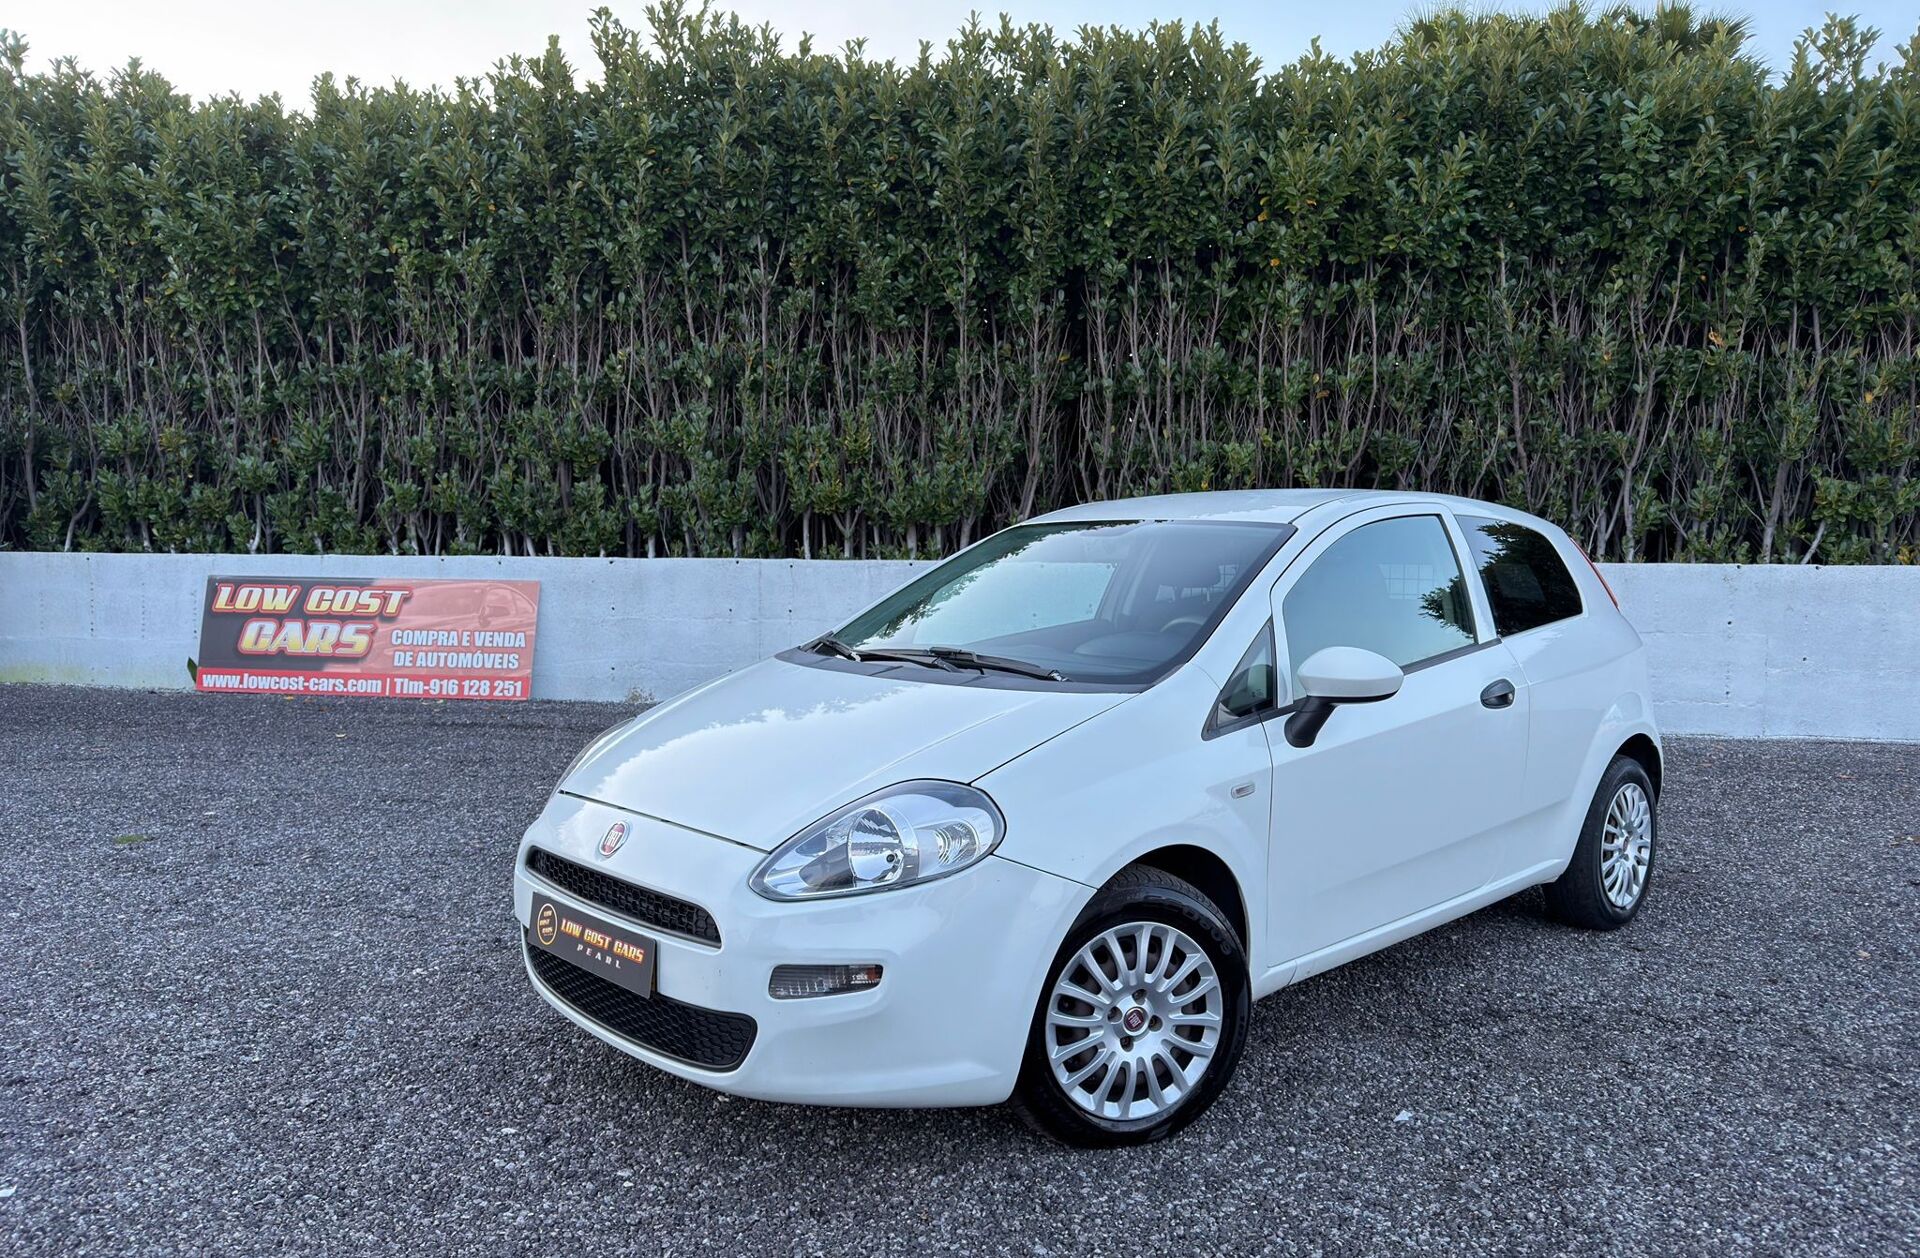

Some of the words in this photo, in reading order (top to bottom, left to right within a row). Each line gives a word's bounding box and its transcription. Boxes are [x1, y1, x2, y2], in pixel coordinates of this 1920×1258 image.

[213, 584, 300, 613] LOW
[304, 586, 412, 617] COST
[239, 619, 375, 656] CARS
[391, 629, 458, 647] COMPRA
[462, 631, 471, 647] E
[474, 631, 526, 648] VENDA
[393, 651, 413, 667] DE
[416, 650, 520, 669] AUTOMÓVEIS
[202, 673, 382, 694] www.lowcost-cars.com
[462, 680, 490, 696] 128
[493, 680, 522, 697] 251
[560, 918, 582, 939] LOW
[584, 928, 612, 950] COST
[613, 940, 645, 965] CARS
[576, 943, 621, 969] PEARL
